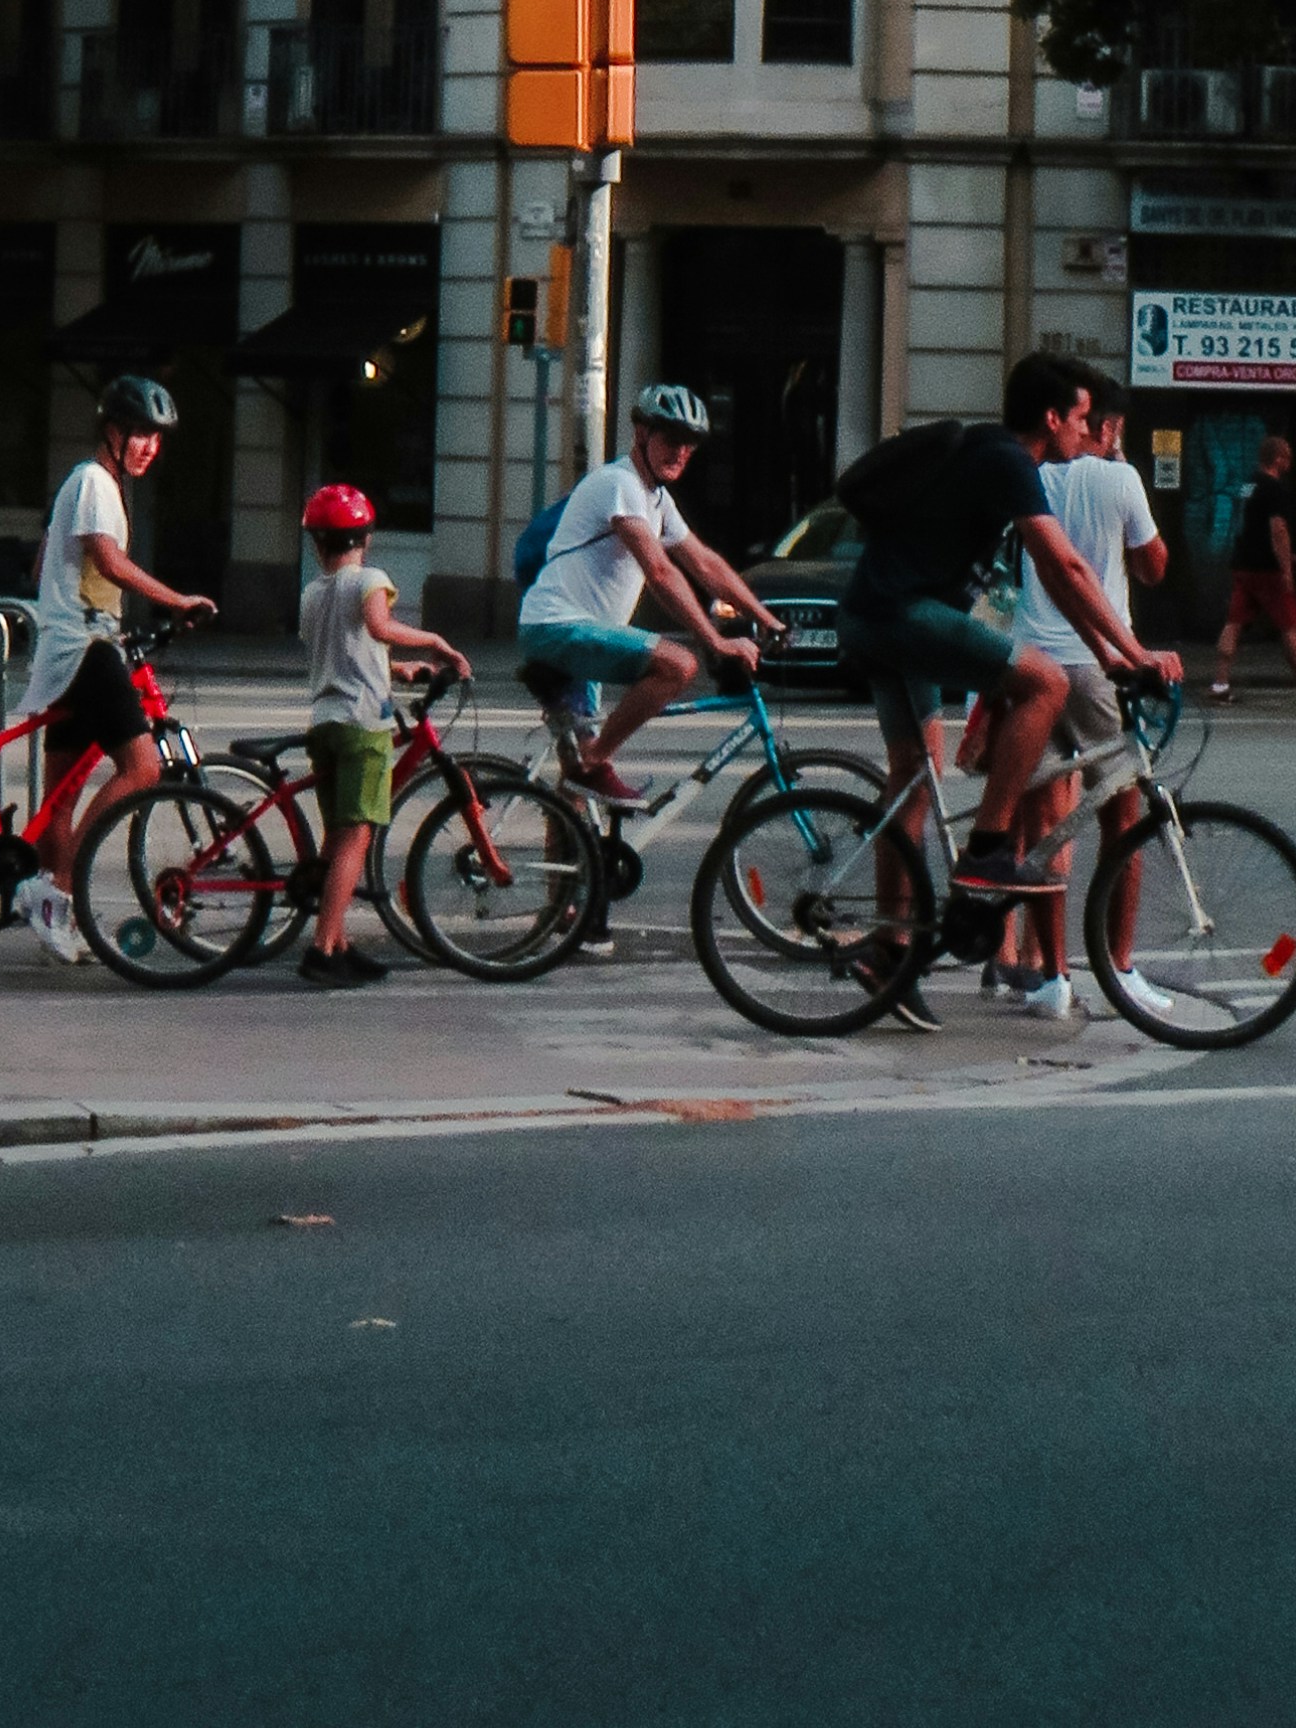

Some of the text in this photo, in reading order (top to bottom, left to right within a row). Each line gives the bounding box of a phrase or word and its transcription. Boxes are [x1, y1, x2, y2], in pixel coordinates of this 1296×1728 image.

[1172, 334, 1192, 356] T.
[1201, 335, 1229, 357] 93
[1238, 337, 1281, 358] 215
[1176, 364, 1271, 379] COMPRA-VENTA
